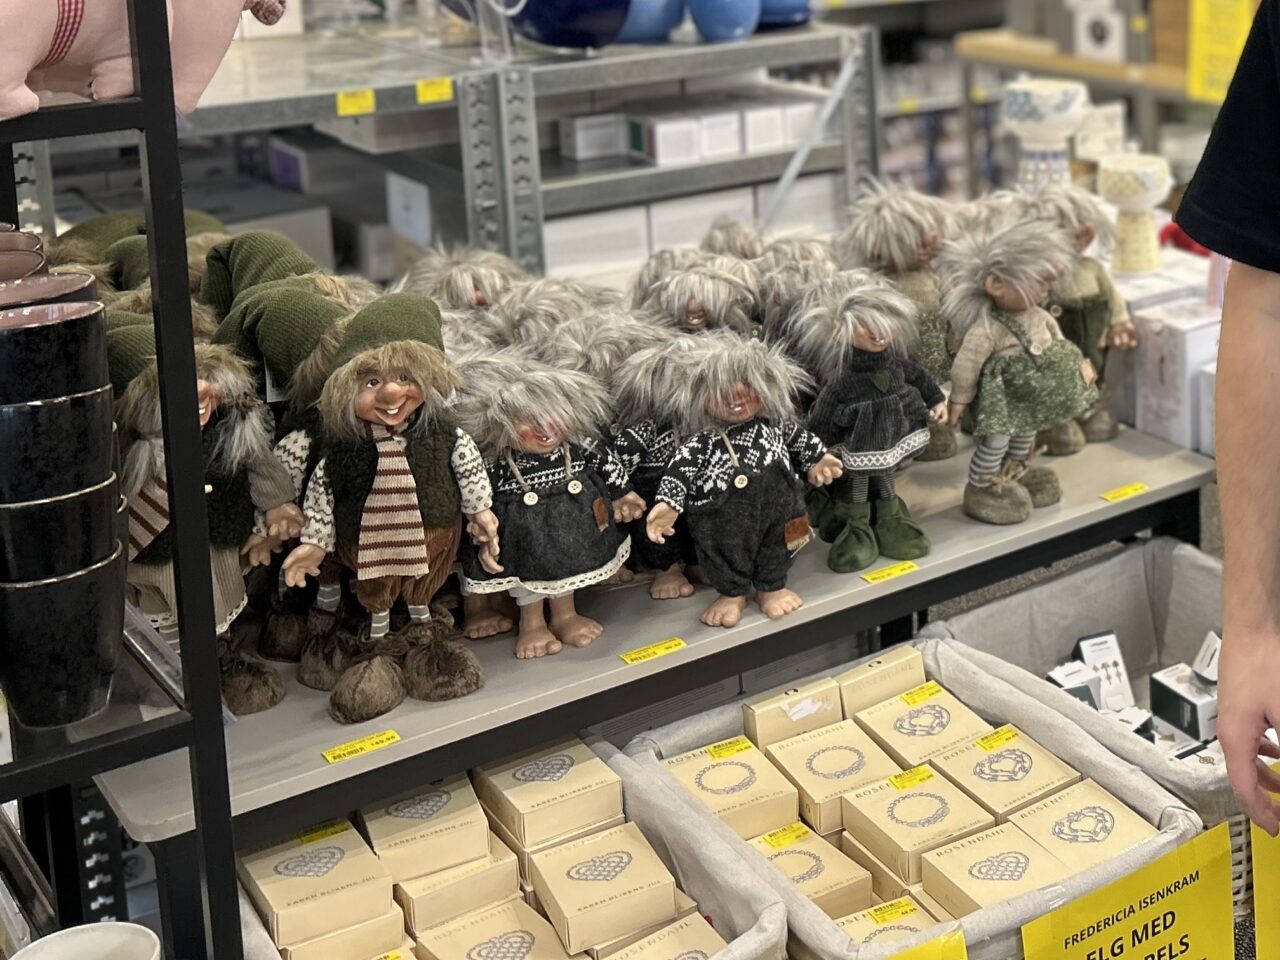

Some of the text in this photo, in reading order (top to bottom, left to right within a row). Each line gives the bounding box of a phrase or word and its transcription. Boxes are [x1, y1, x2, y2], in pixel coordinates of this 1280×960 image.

[668, 749, 708, 765] ROSEN
[1064, 870, 1200, 950] FREDERICIA ISENKRAM
[1131, 910, 1177, 948] MED
